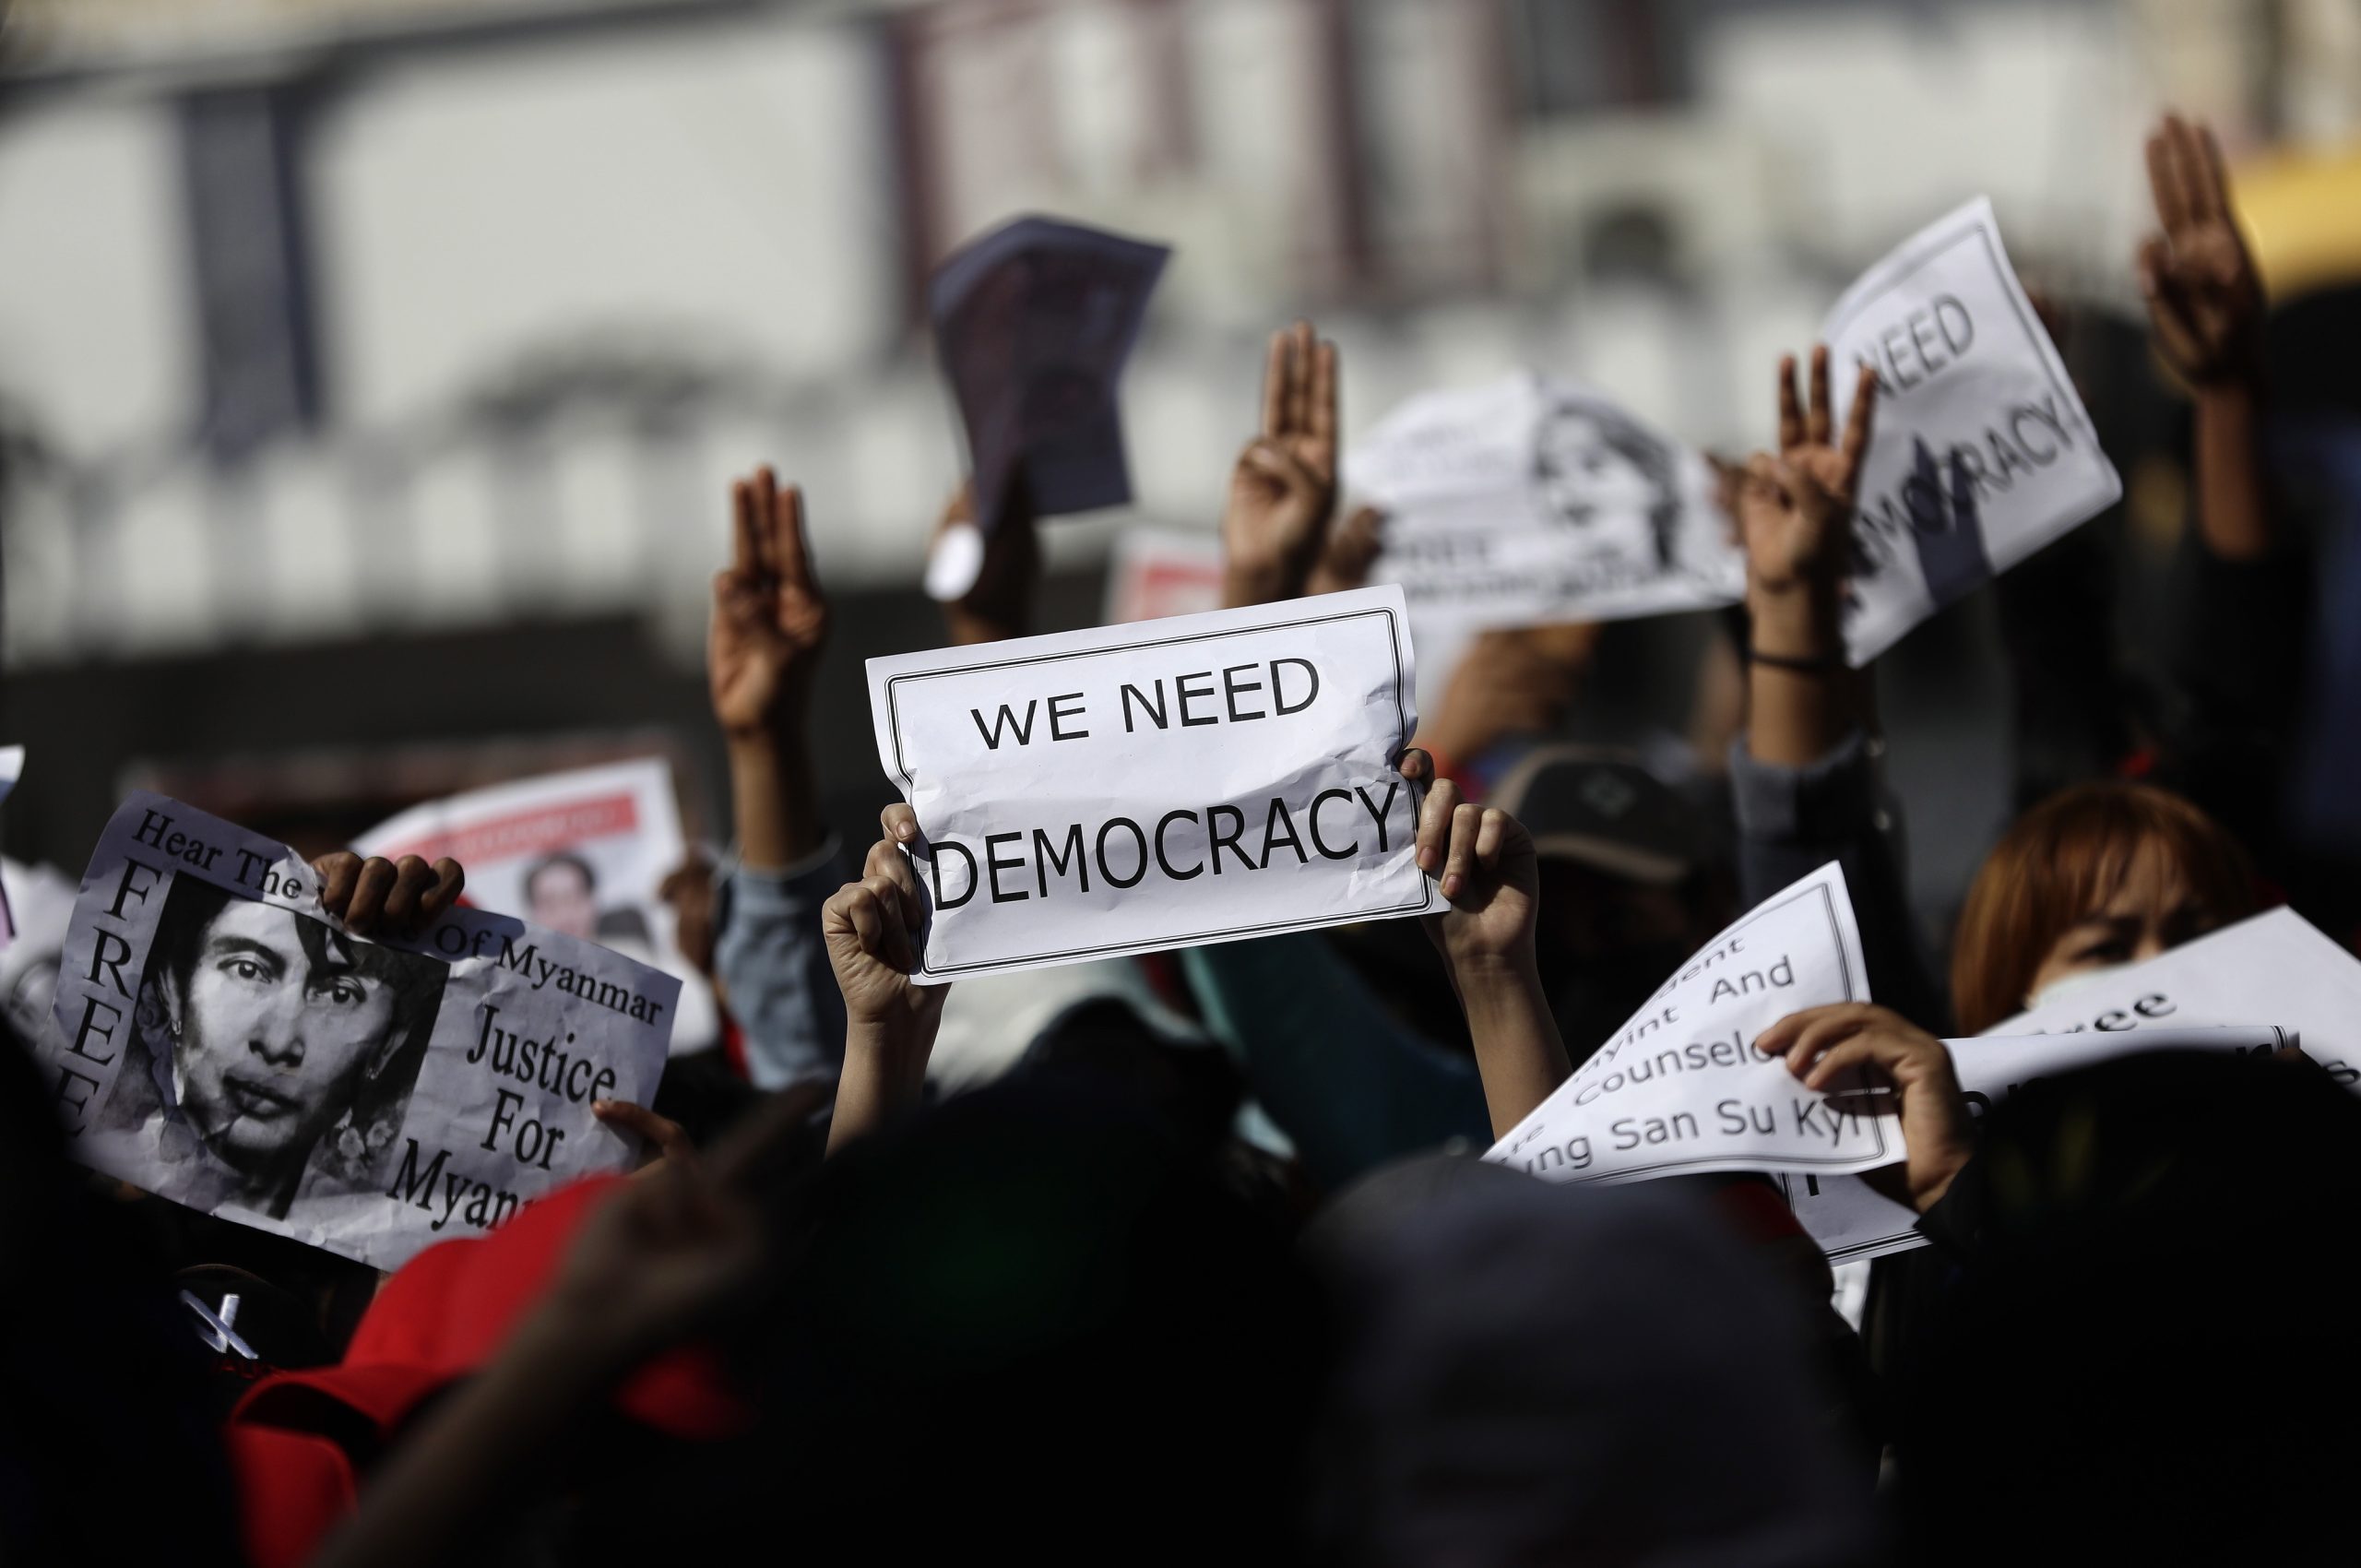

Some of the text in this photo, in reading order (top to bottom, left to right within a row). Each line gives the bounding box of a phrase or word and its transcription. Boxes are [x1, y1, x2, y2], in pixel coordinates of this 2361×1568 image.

[970, 658, 1321, 750] WE NEED
[927, 781, 1400, 910] DEMOCRACY
[130, 809, 663, 1027] Hear The Of Myanmar
[1711, 955, 1796, 1004] And
[467, 1004, 617, 1105] Justice
[1574, 1030, 1773, 1106] Counselo
[481, 1087, 564, 1170] For
[1610, 1111, 1700, 1151] San
[1716, 1099, 1776, 1136] Su
[1793, 1098, 1861, 1150] Kyi
[386, 1137, 537, 1231] Myan
